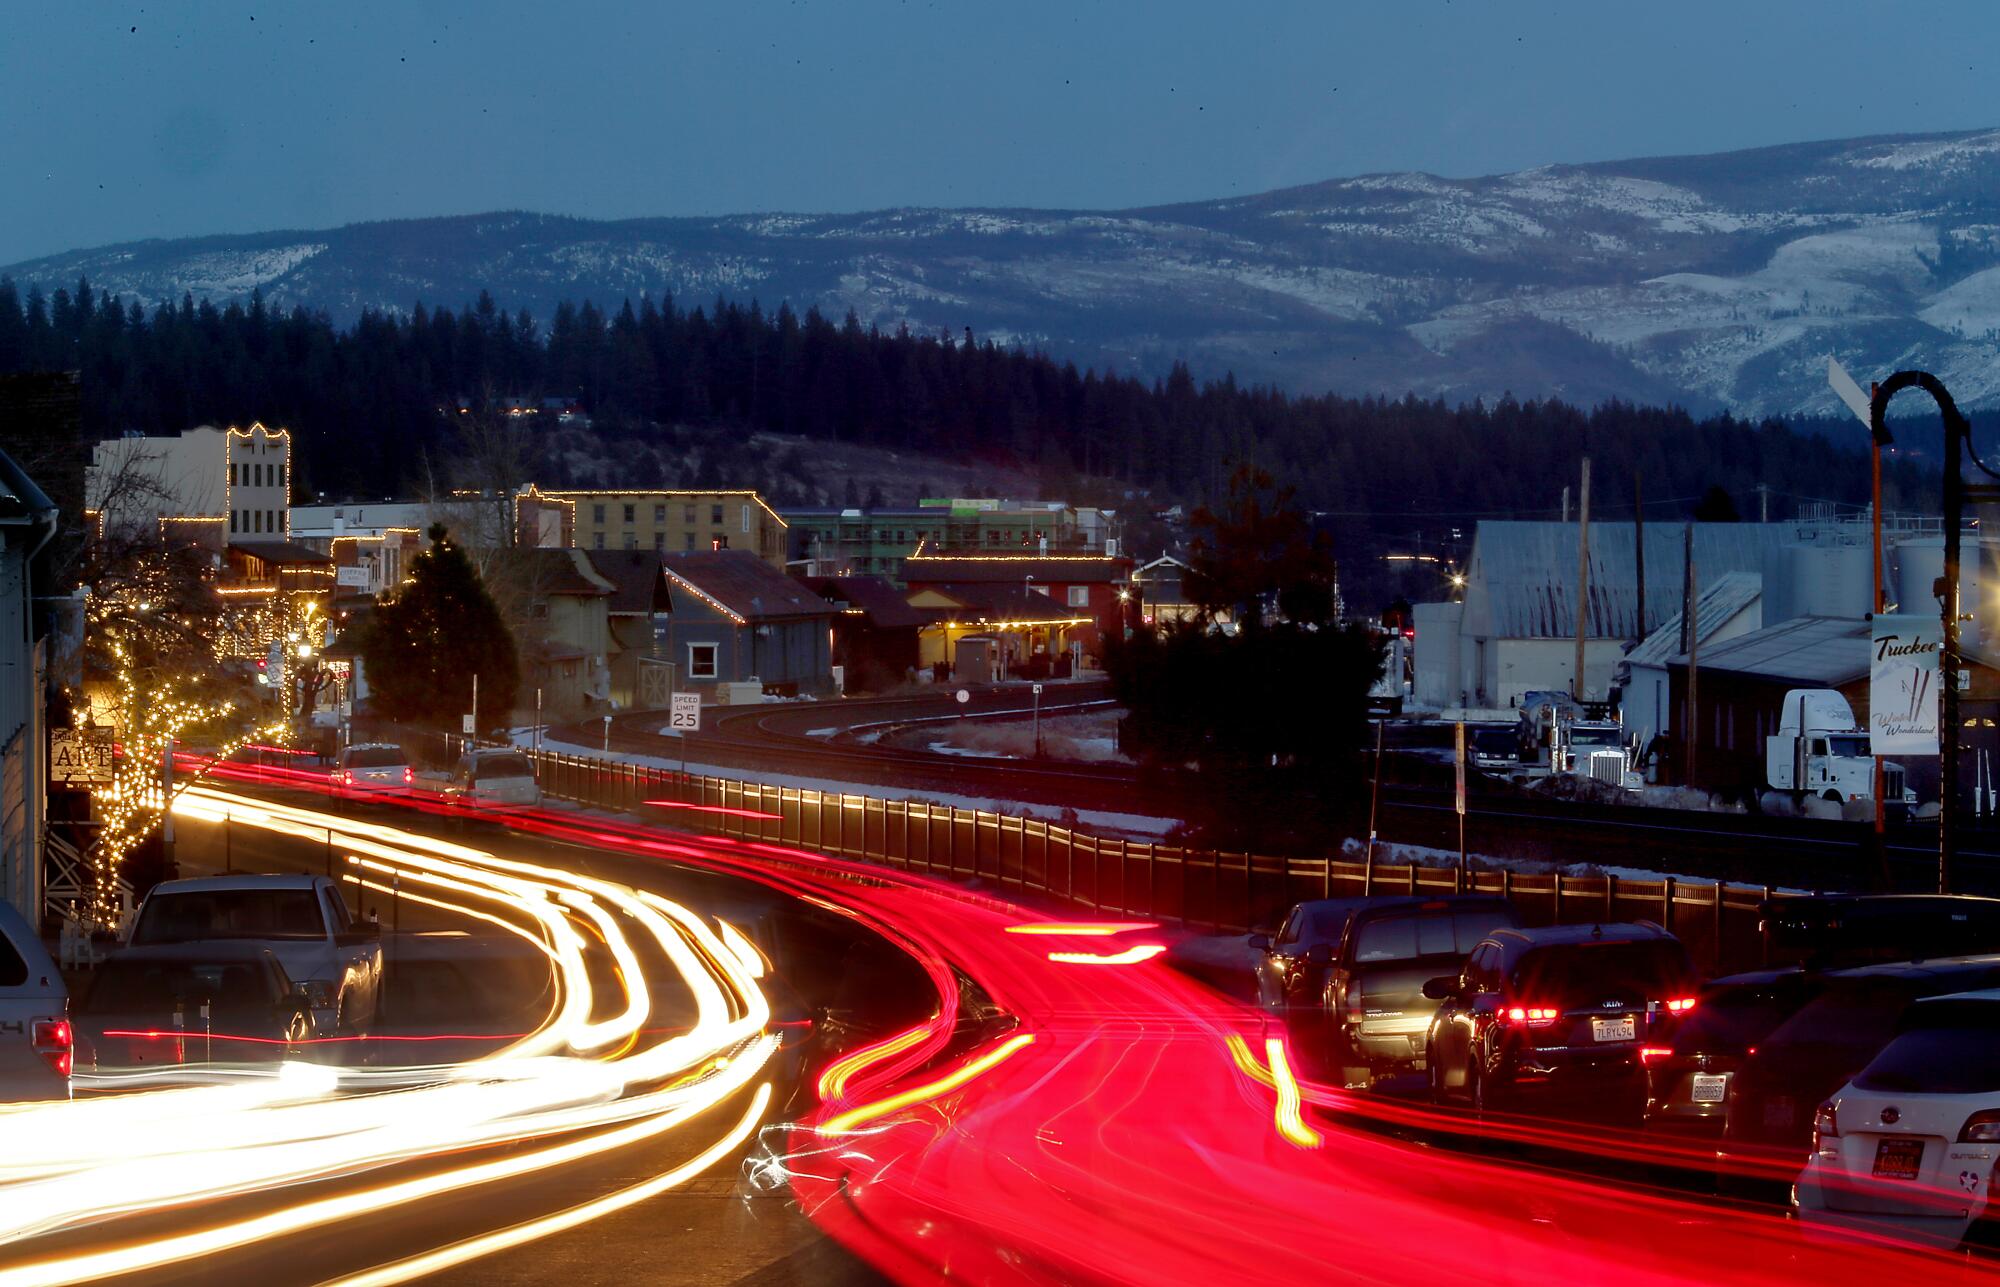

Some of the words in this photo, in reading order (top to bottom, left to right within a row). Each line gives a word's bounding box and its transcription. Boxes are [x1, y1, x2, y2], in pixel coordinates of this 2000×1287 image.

[1874, 635, 1938, 661] Truckee
[673, 713, 696, 727] 25
[1881, 725, 1936, 736] Wonderland
[1596, 1026, 1632, 1039] 7LRY494
